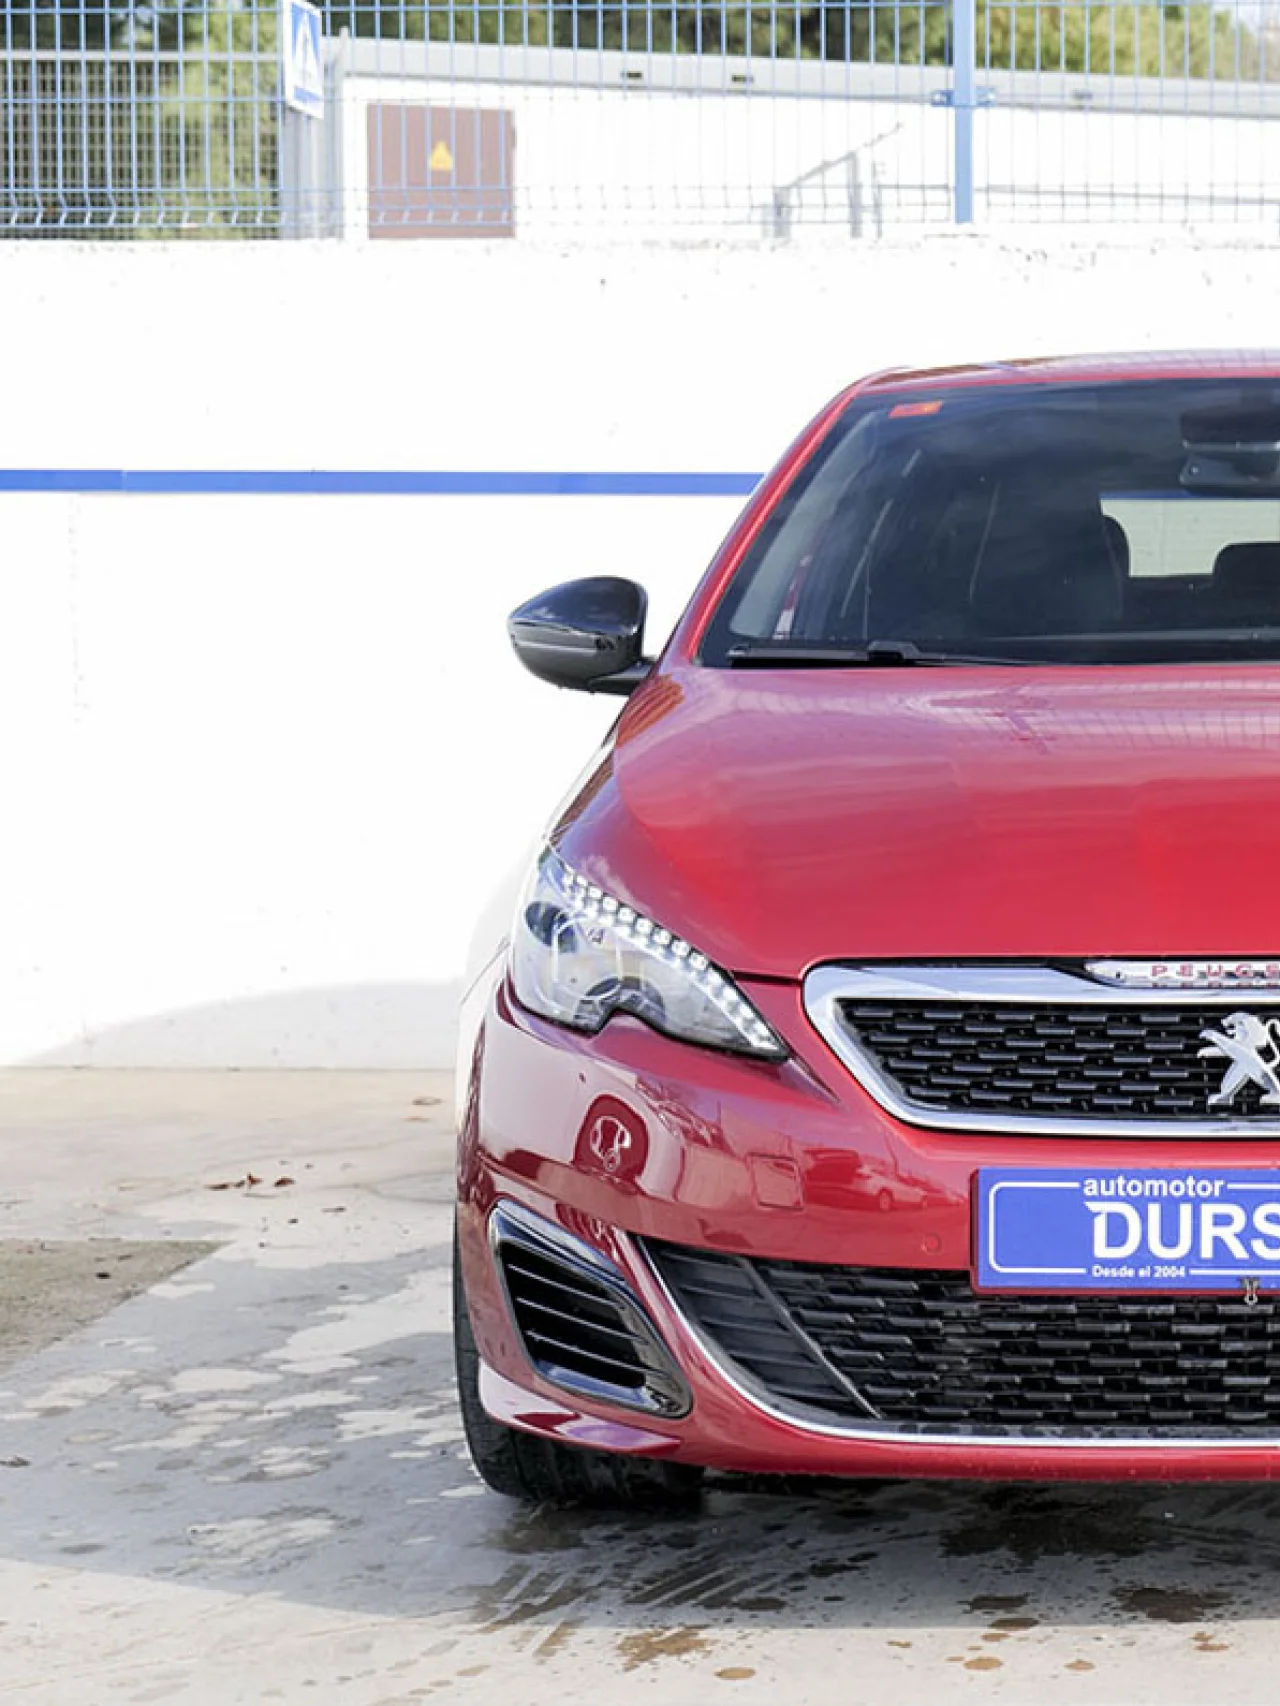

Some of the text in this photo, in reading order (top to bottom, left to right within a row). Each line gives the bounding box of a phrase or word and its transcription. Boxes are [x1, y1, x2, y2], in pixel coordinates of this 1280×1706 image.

[1083, 1175, 1224, 1198] automotor
[1092, 1265, 1186, 1278] Desde el 2004
